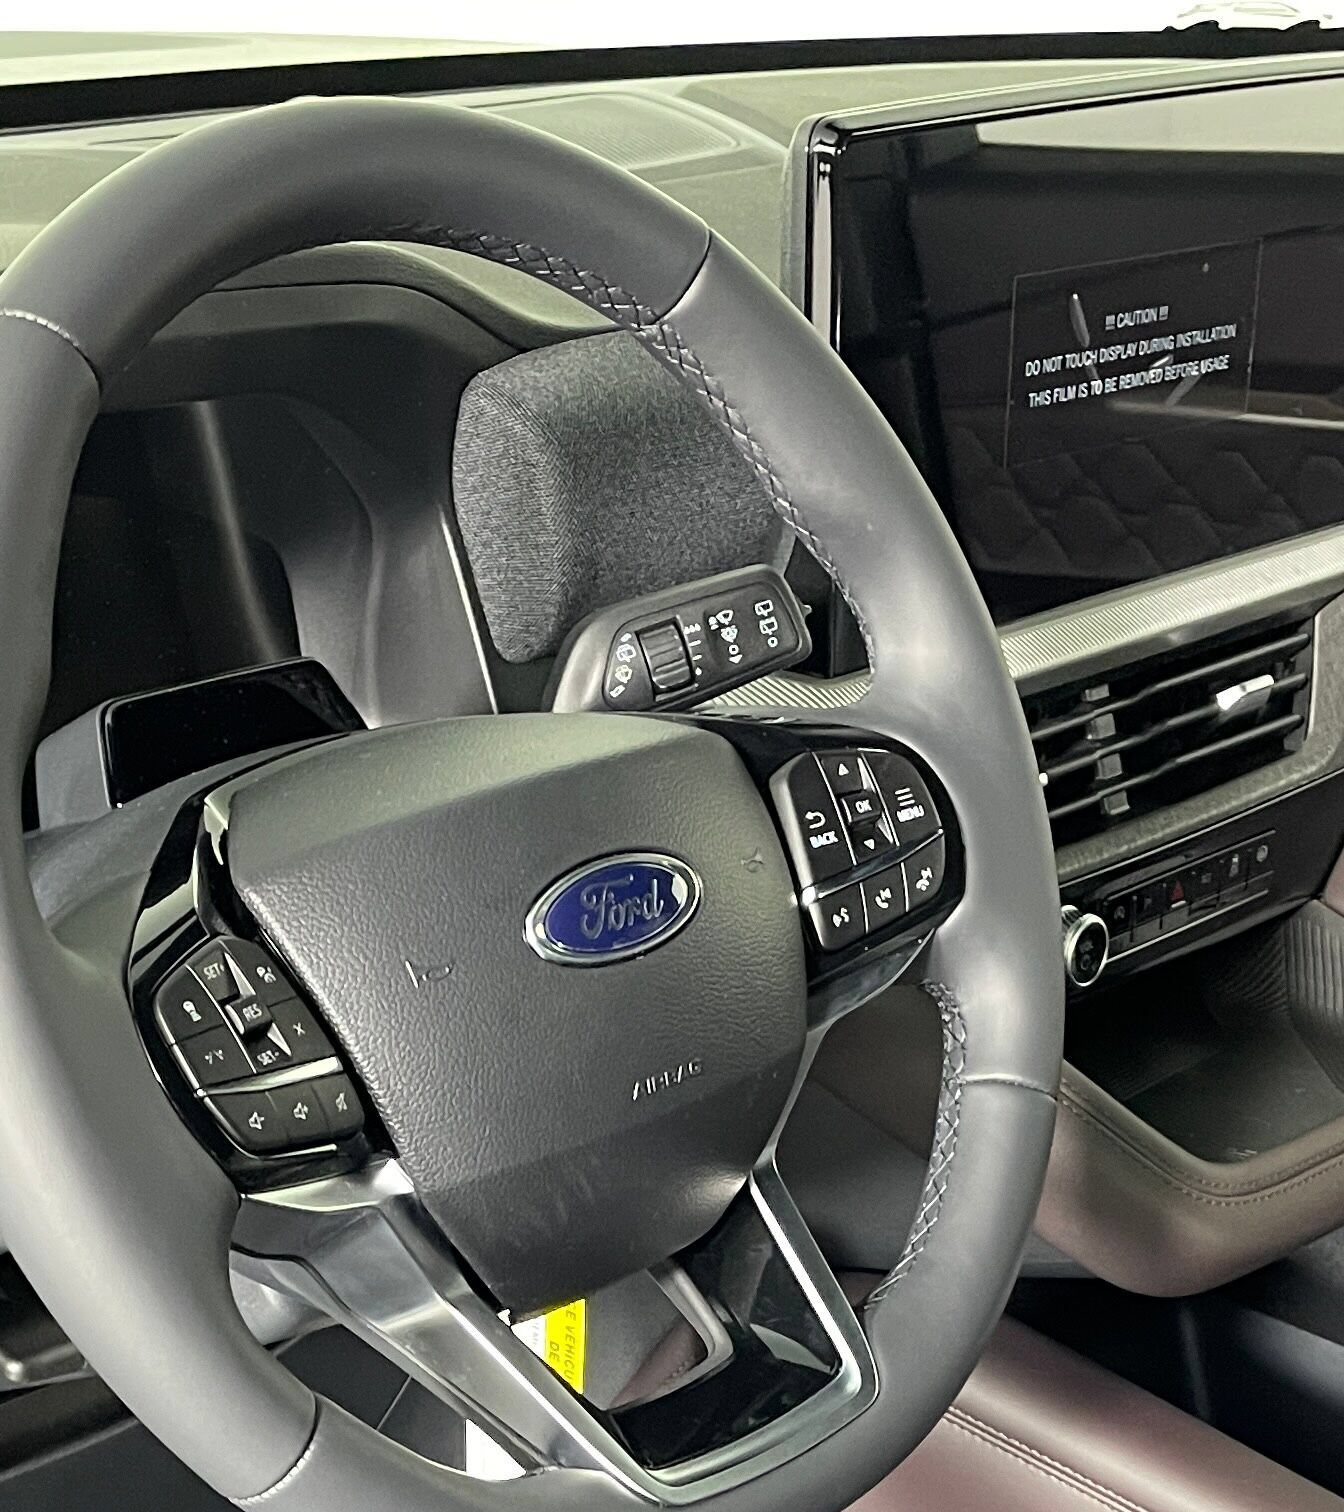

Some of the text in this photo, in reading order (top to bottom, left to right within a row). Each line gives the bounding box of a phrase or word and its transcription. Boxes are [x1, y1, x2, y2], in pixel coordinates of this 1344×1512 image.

[1116, 306, 1159, 329] CAUTION
[1025, 323, 1238, 377] DO NOT TOUCH DISPLAY DURING INSTALLATION
[1028, 354, 1231, 408] THIS FILM IS TO BE REMOVED BEFORE USAGE
[856, 799, 872, 814] OK
[896, 805, 925, 823] MENU
[809, 831, 839, 849] BACK
[580, 873, 664, 940] Ford
[242, 1003, 263, 1022] RES
